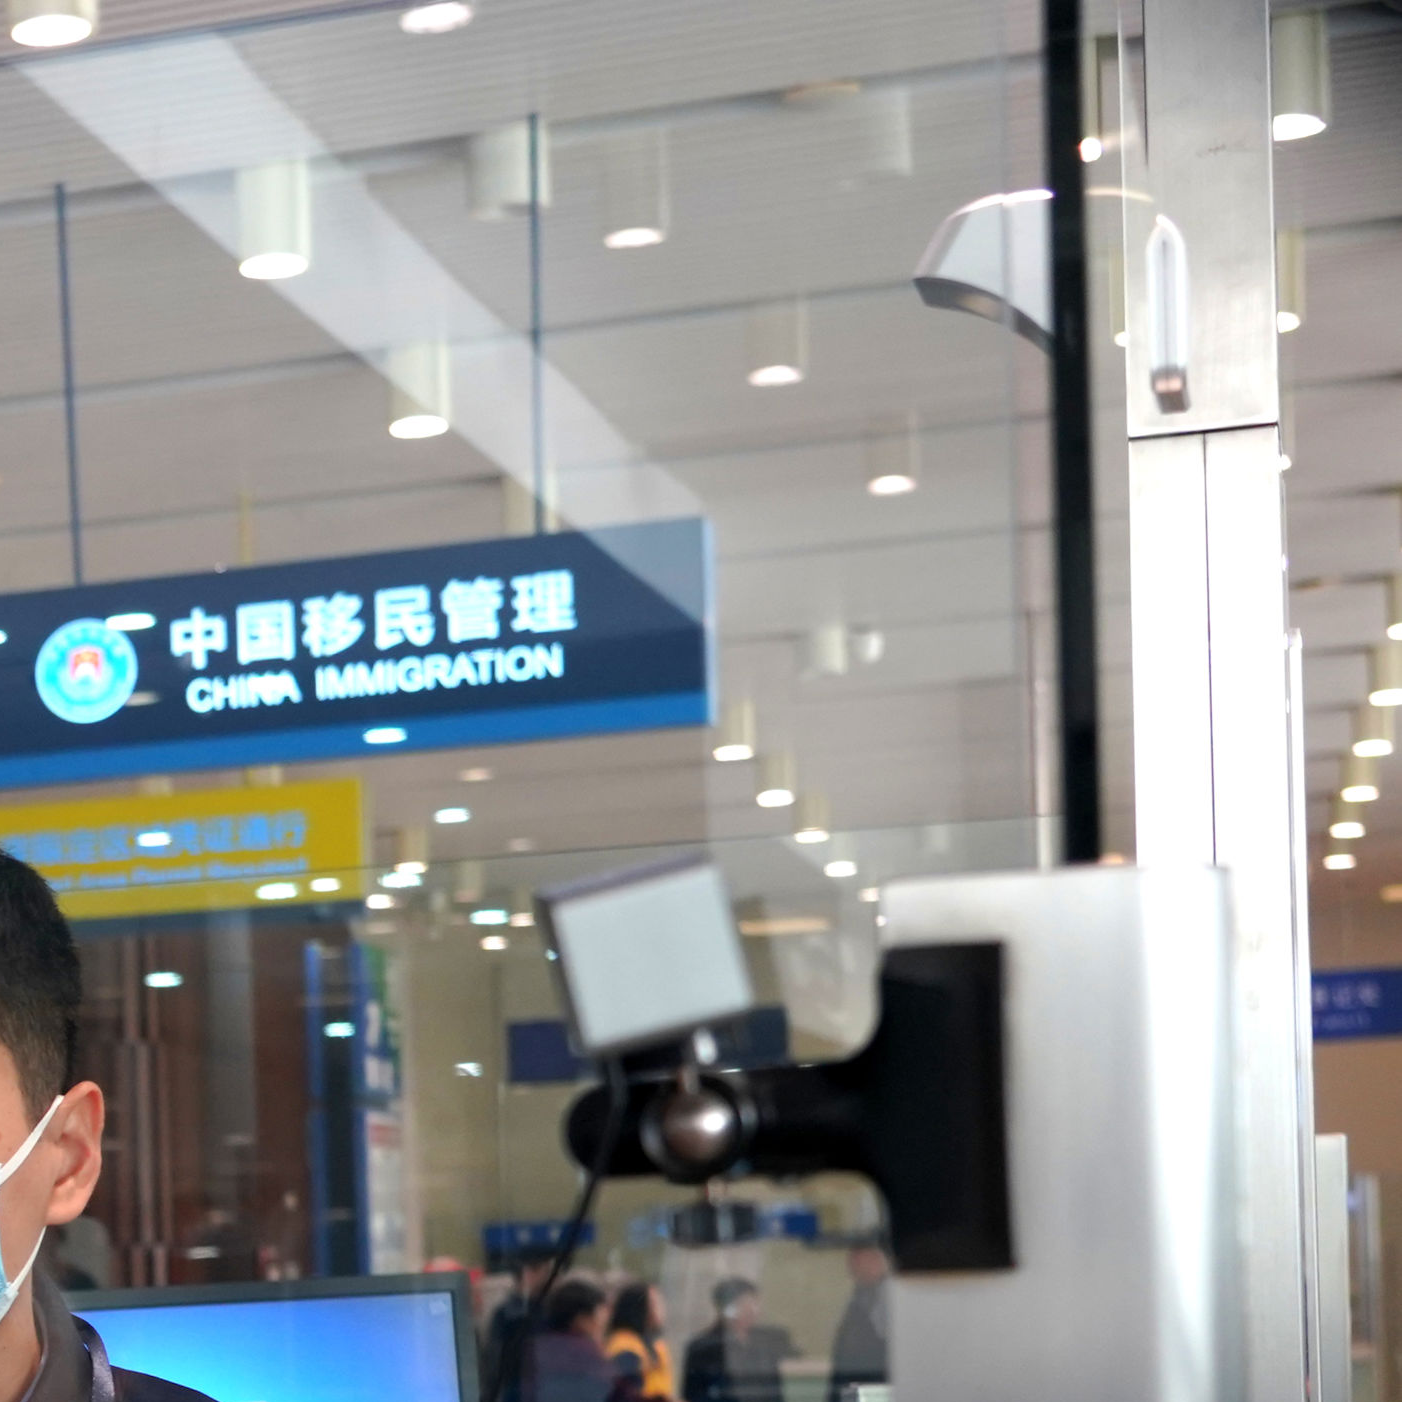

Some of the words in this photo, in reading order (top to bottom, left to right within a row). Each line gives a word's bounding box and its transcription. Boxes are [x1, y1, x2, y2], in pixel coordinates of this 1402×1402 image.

[170, 569, 578, 670] 中国移民管理
[186, 669, 302, 713] CHINA
[314, 641, 564, 701] IMMIGRATION
